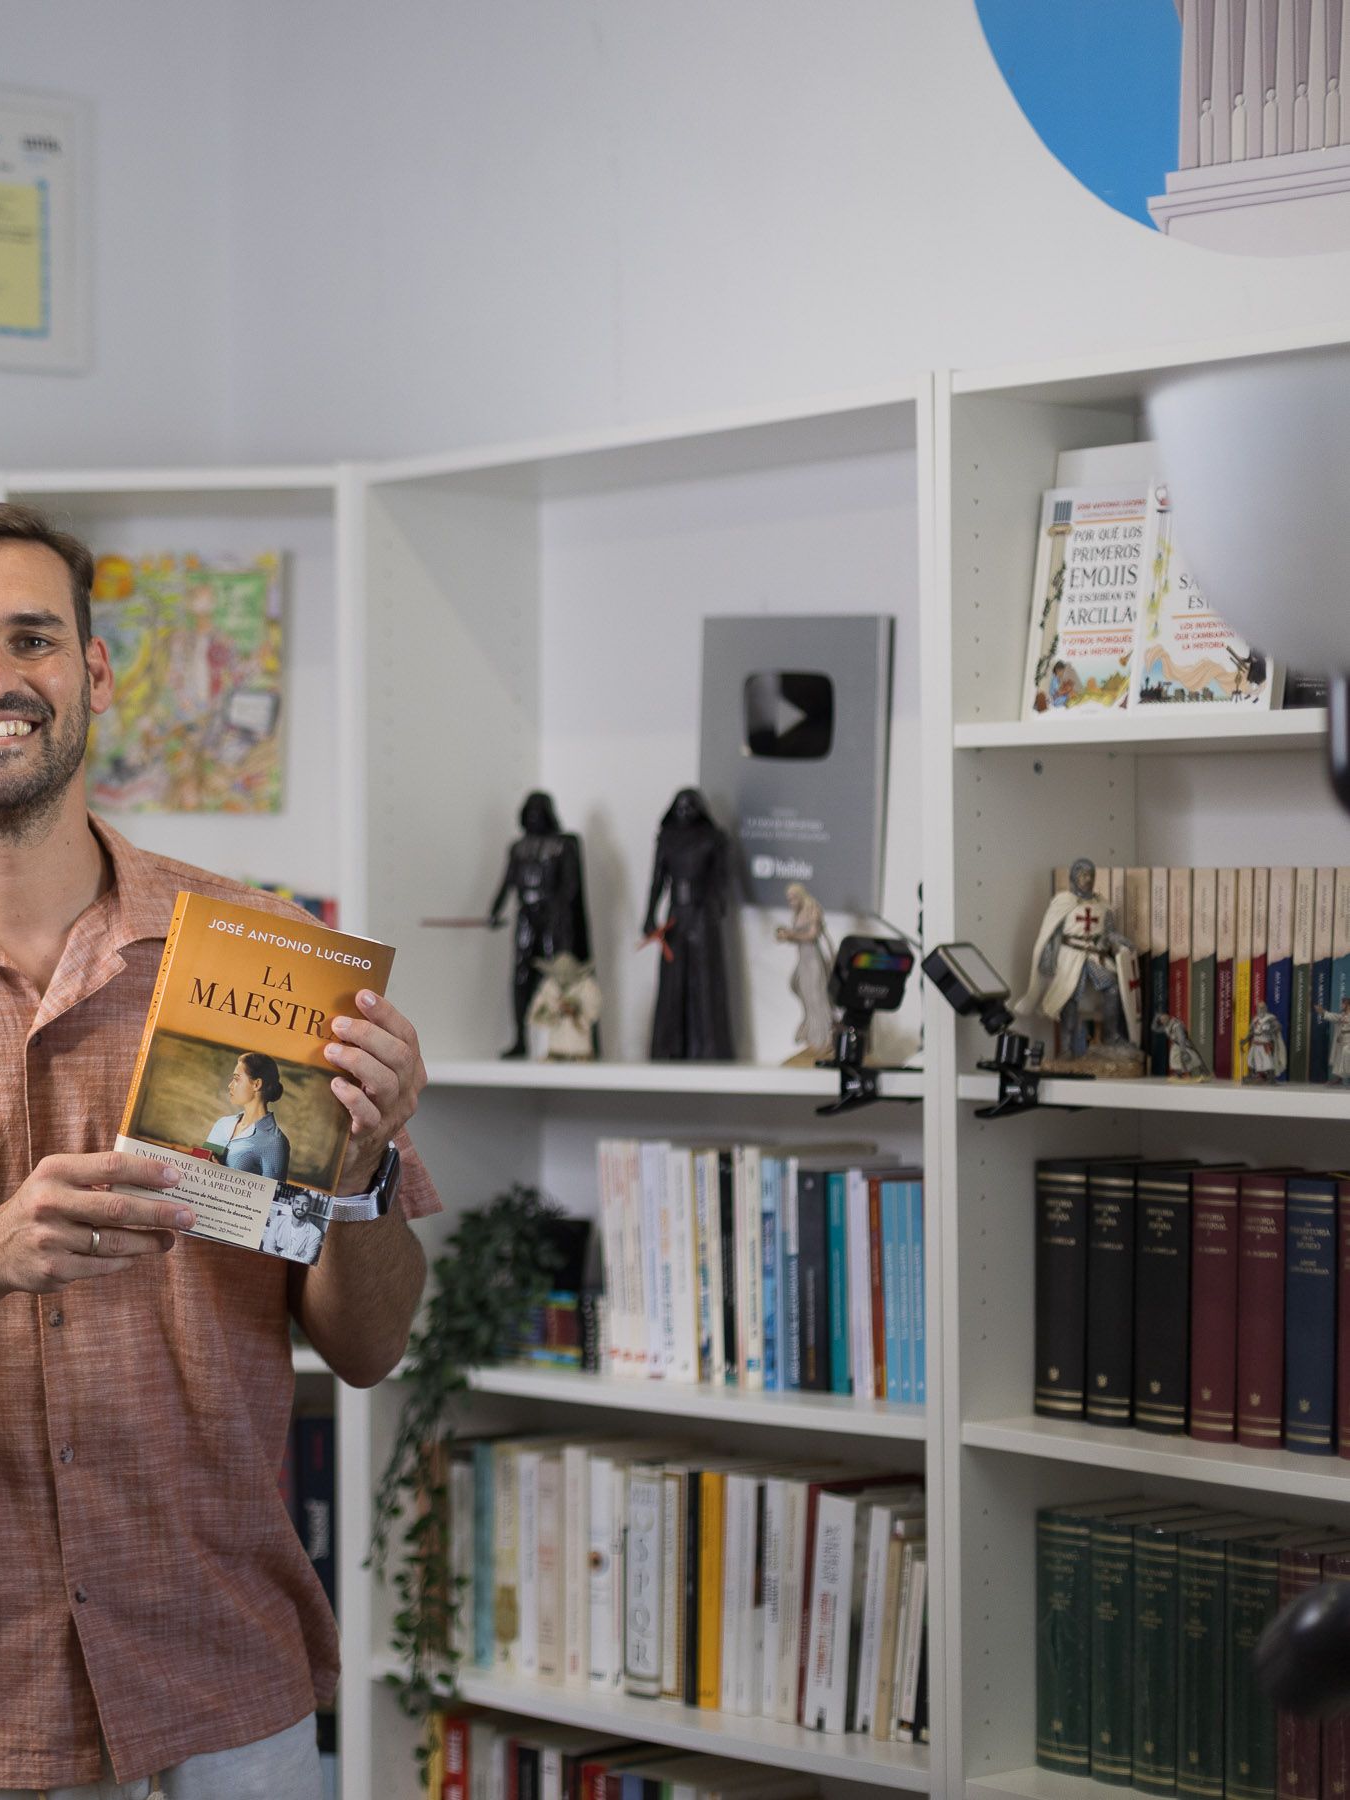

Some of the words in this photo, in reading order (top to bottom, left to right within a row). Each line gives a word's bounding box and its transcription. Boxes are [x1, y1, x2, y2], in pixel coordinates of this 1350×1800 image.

[1123, 526, 1143, 538] LOS
[1072, 543, 1141, 562] PRIMEROS
[1070, 563, 1138, 588] EMOJIS
[208, 918, 245, 937] JOSÉ
[247, 930, 312, 955] ANTONIO
[316, 947, 372, 970] LUCERO
[261, 965, 294, 992] LA
[188, 977, 336, 1040] MAESTR
[135, 1148, 148, 1158] UN
[149, 1152, 194, 1171] HOMENAJE
[202, 1167, 246, 1186] AQUELLOS
[248, 1181, 266, 1192] QUE
[208, 1181, 252, 1198] APRENDER
